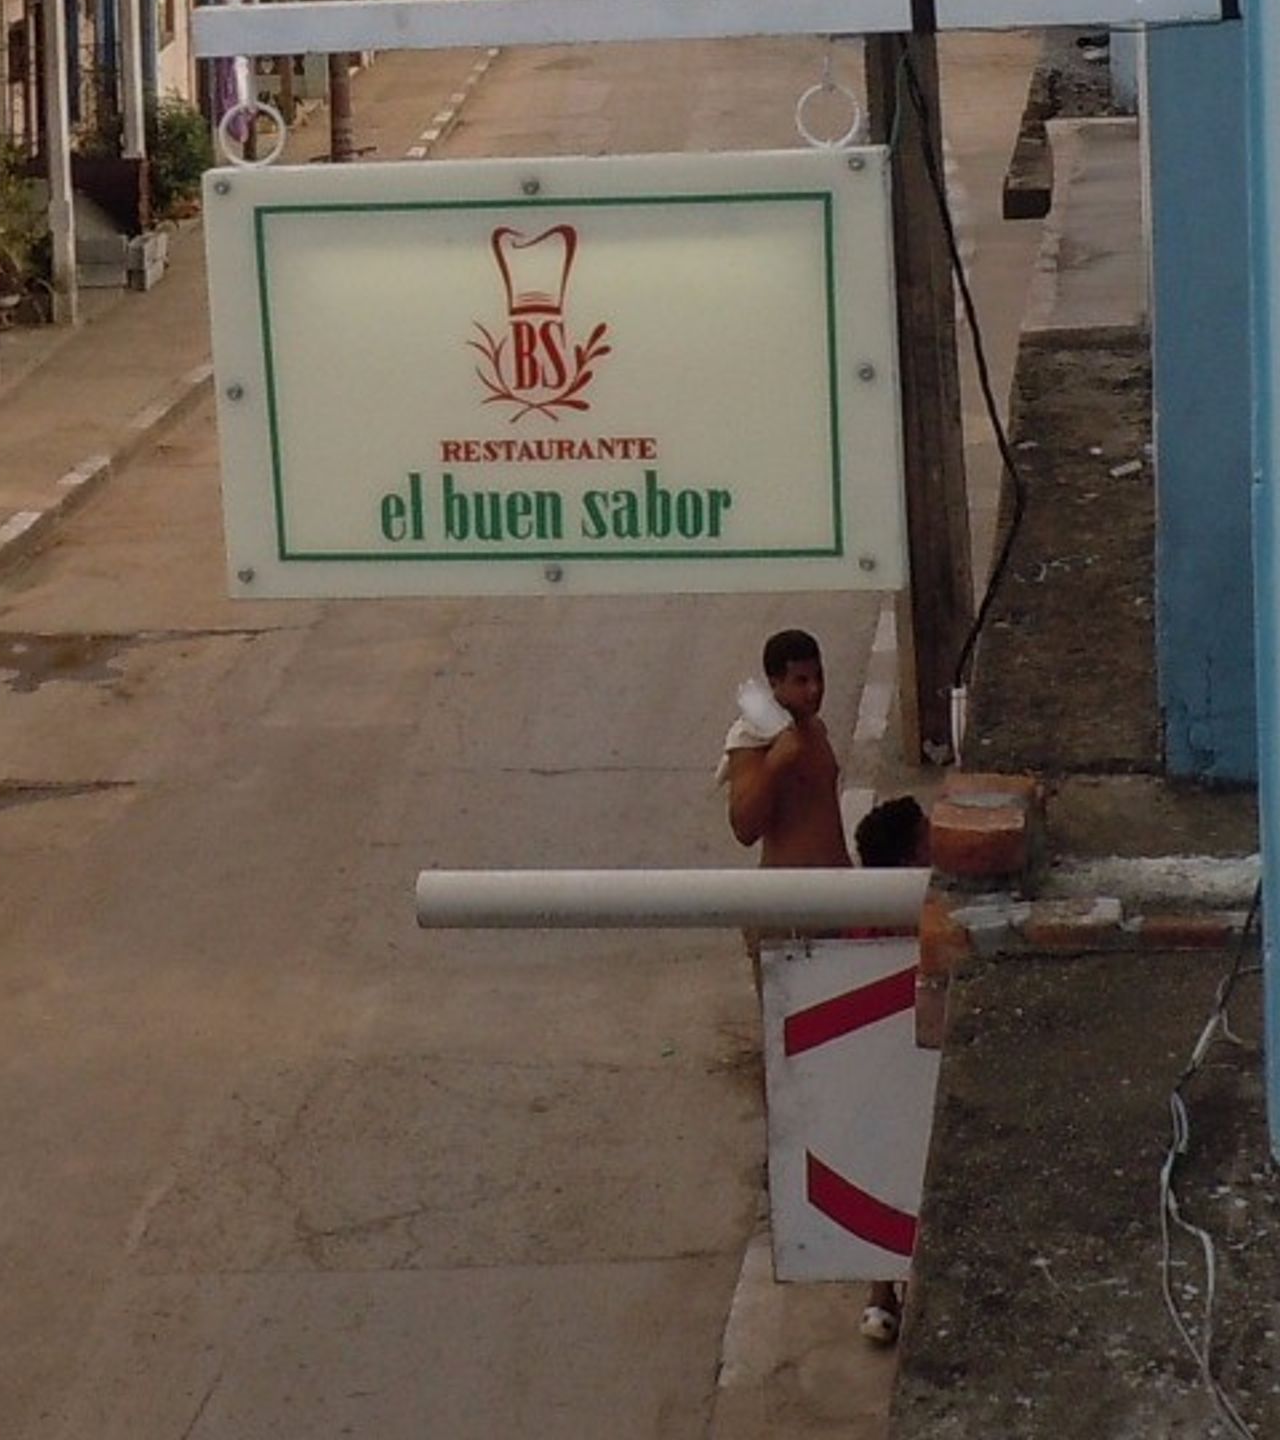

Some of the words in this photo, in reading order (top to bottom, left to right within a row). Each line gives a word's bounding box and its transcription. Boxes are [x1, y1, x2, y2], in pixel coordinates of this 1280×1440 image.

[513, 320, 569, 390] BS
[441, 437, 657, 462] RESTAURANTE
[380, 471, 424, 542] el
[443, 472, 563, 540] buen
[580, 470, 732, 539] sabor
